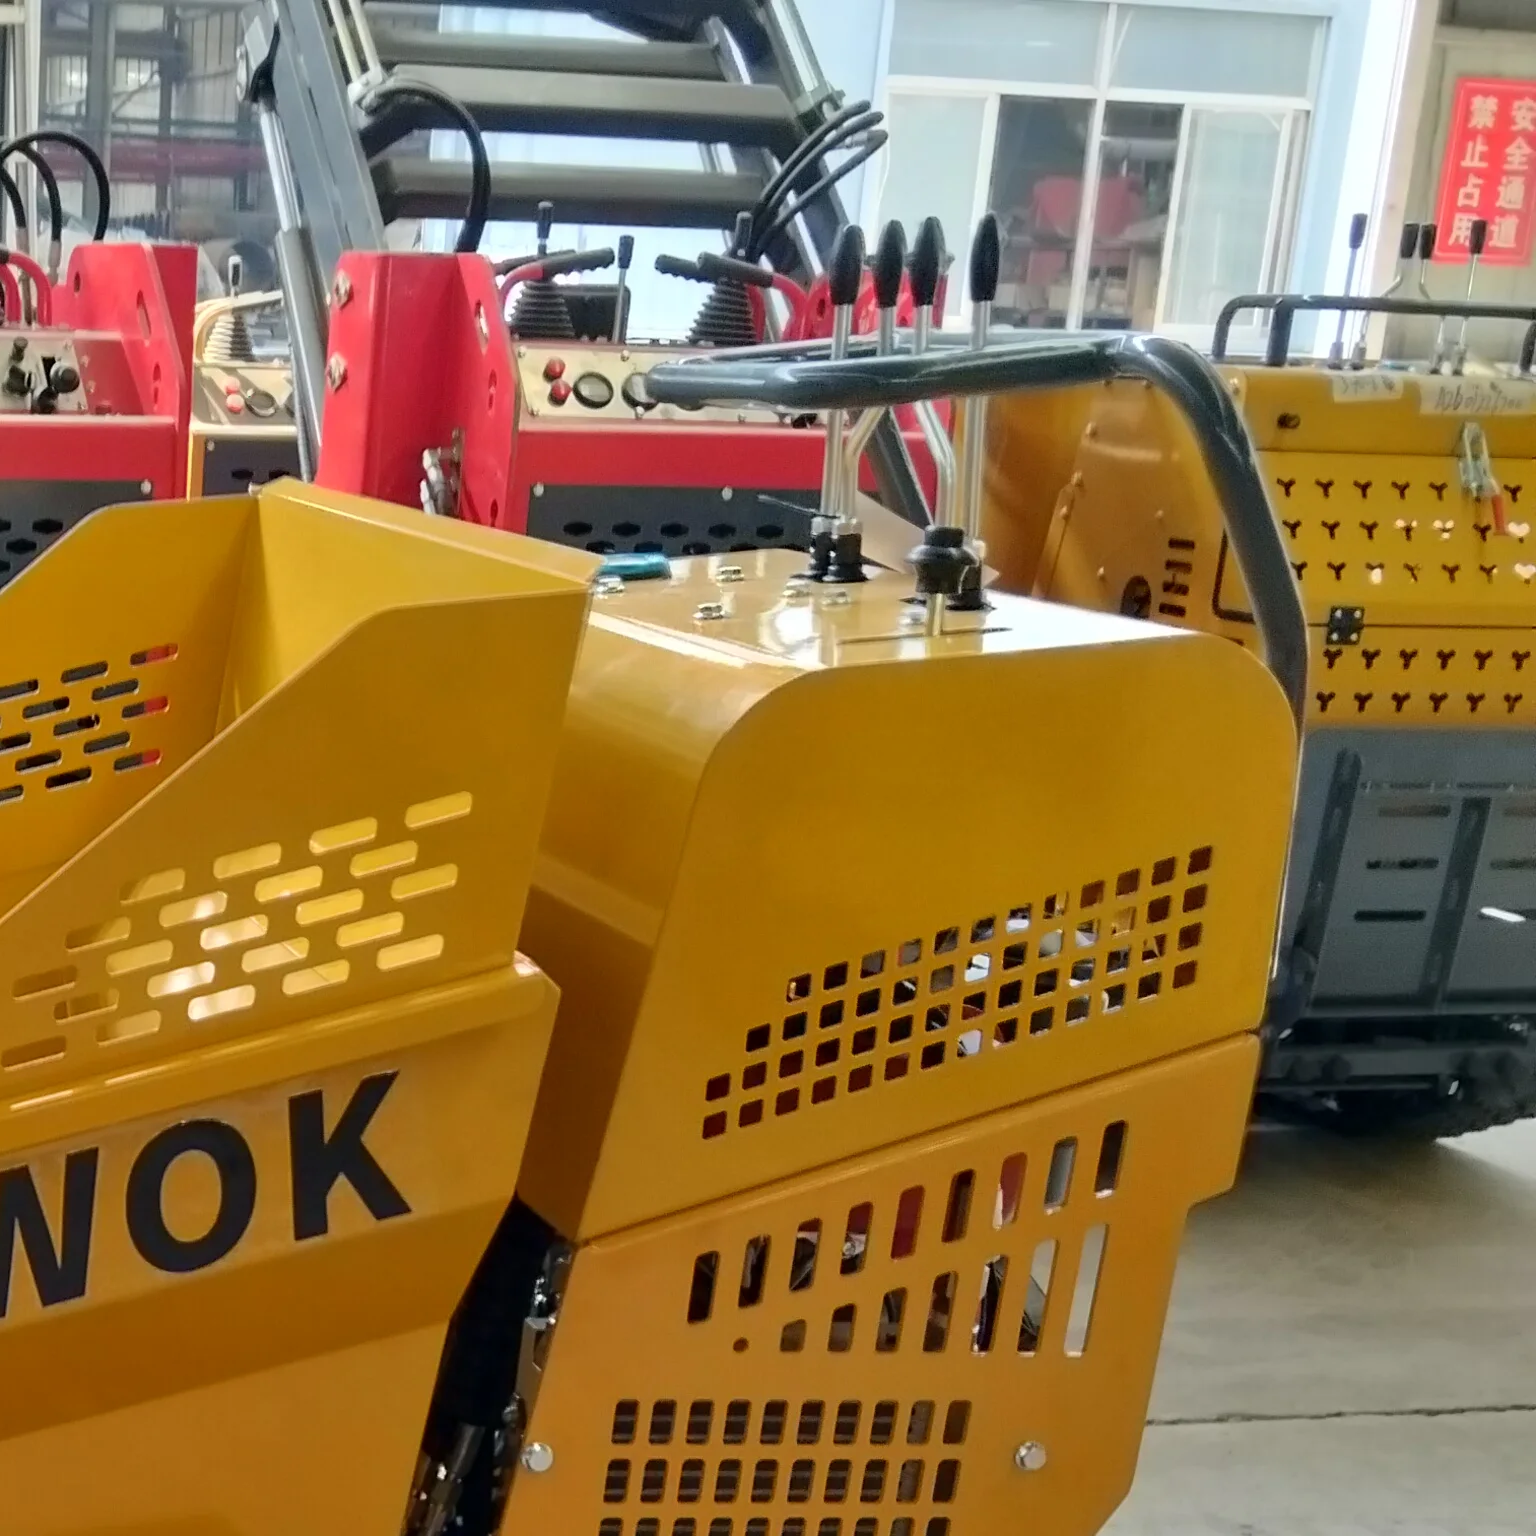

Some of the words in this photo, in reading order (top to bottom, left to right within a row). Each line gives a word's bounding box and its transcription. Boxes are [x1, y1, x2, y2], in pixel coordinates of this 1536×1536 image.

[1448, 94, 1498, 247] 禁止占用
[1488, 96, 1536, 248] 安全通道
